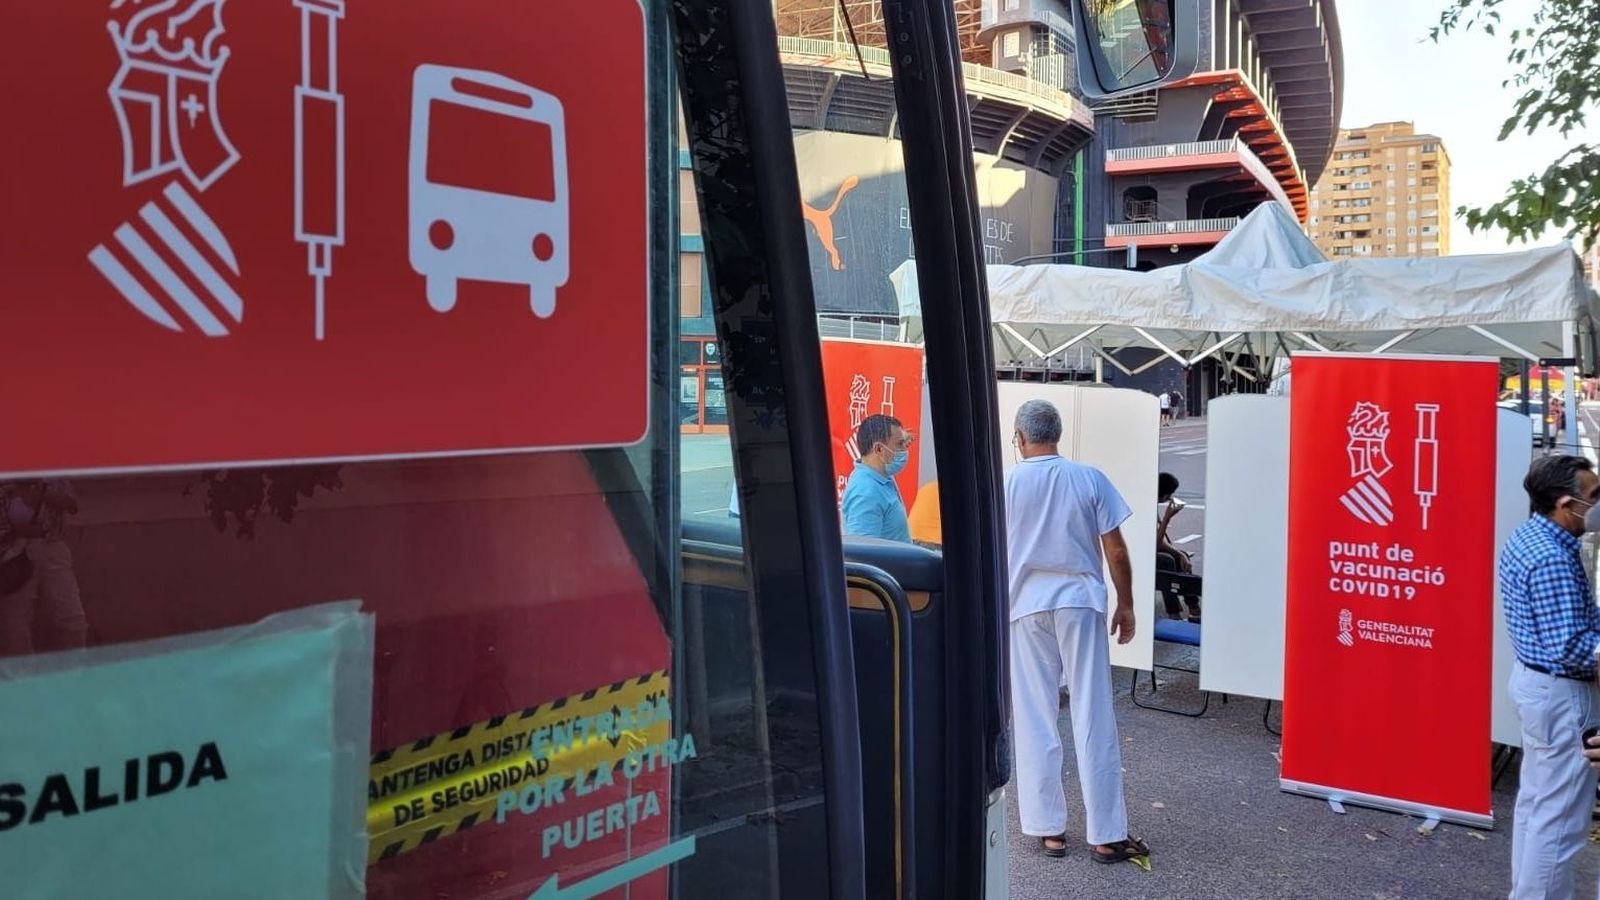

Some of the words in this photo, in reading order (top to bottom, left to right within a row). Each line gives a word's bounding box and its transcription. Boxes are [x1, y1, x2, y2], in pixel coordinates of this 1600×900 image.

[1000, 221, 1014, 243] DE
[1329, 540, 1379, 559] punt
[1385, 544, 1414, 562] de
[1329, 560, 1446, 586] vacunació
[1329, 577, 1416, 600] COVID19
[1357, 619, 1435, 638] GENERALITAT
[1357, 629, 1433, 649] VALENCIANA
[532, 696, 672, 760] ENTRADA
[0, 741, 228, 831] SALIDA
[368, 750, 475, 799] ANTENGA
[393, 798, 425, 826] DE
[431, 757, 549, 813] SEGURIDAD
[496, 773, 566, 824] POR
[576, 760, 615, 797] LA
[623, 733, 697, 779] OTRA
[542, 791, 661, 859] PUERTA
